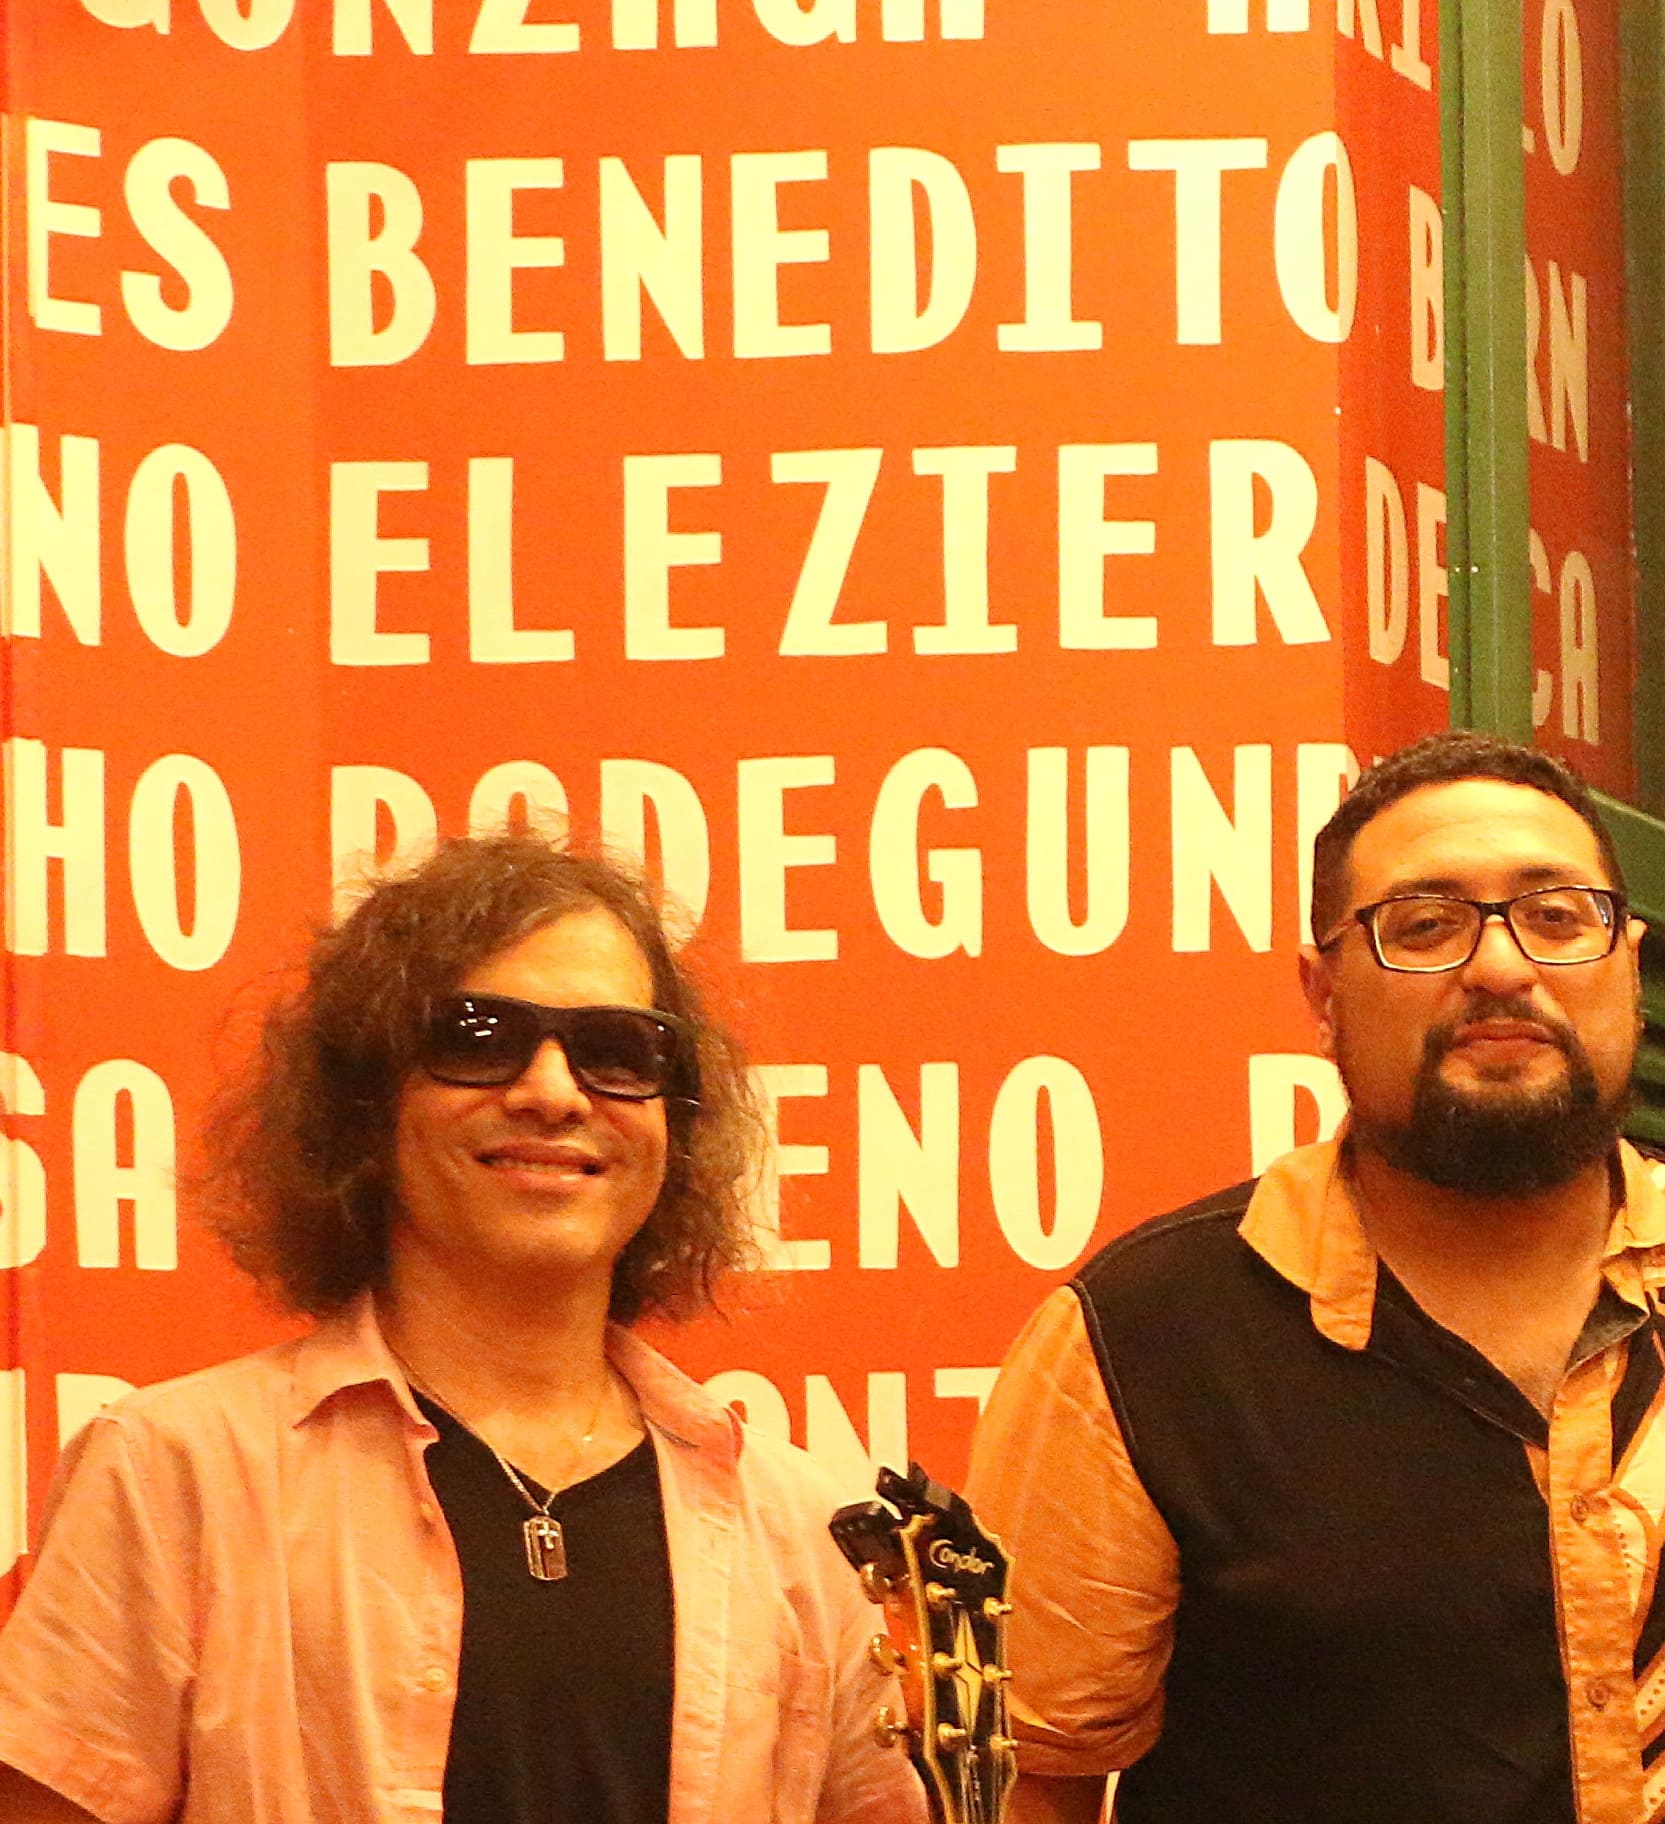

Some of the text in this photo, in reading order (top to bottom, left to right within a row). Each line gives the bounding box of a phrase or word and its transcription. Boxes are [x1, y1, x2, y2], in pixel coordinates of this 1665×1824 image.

[26, 116, 234, 352] ES
[325, 130, 1357, 367] BENEDITO
[0, 421, 237, 659] NO
[329, 438, 1332, 666] ELEZIER
[2, 737, 242, 972] HO
